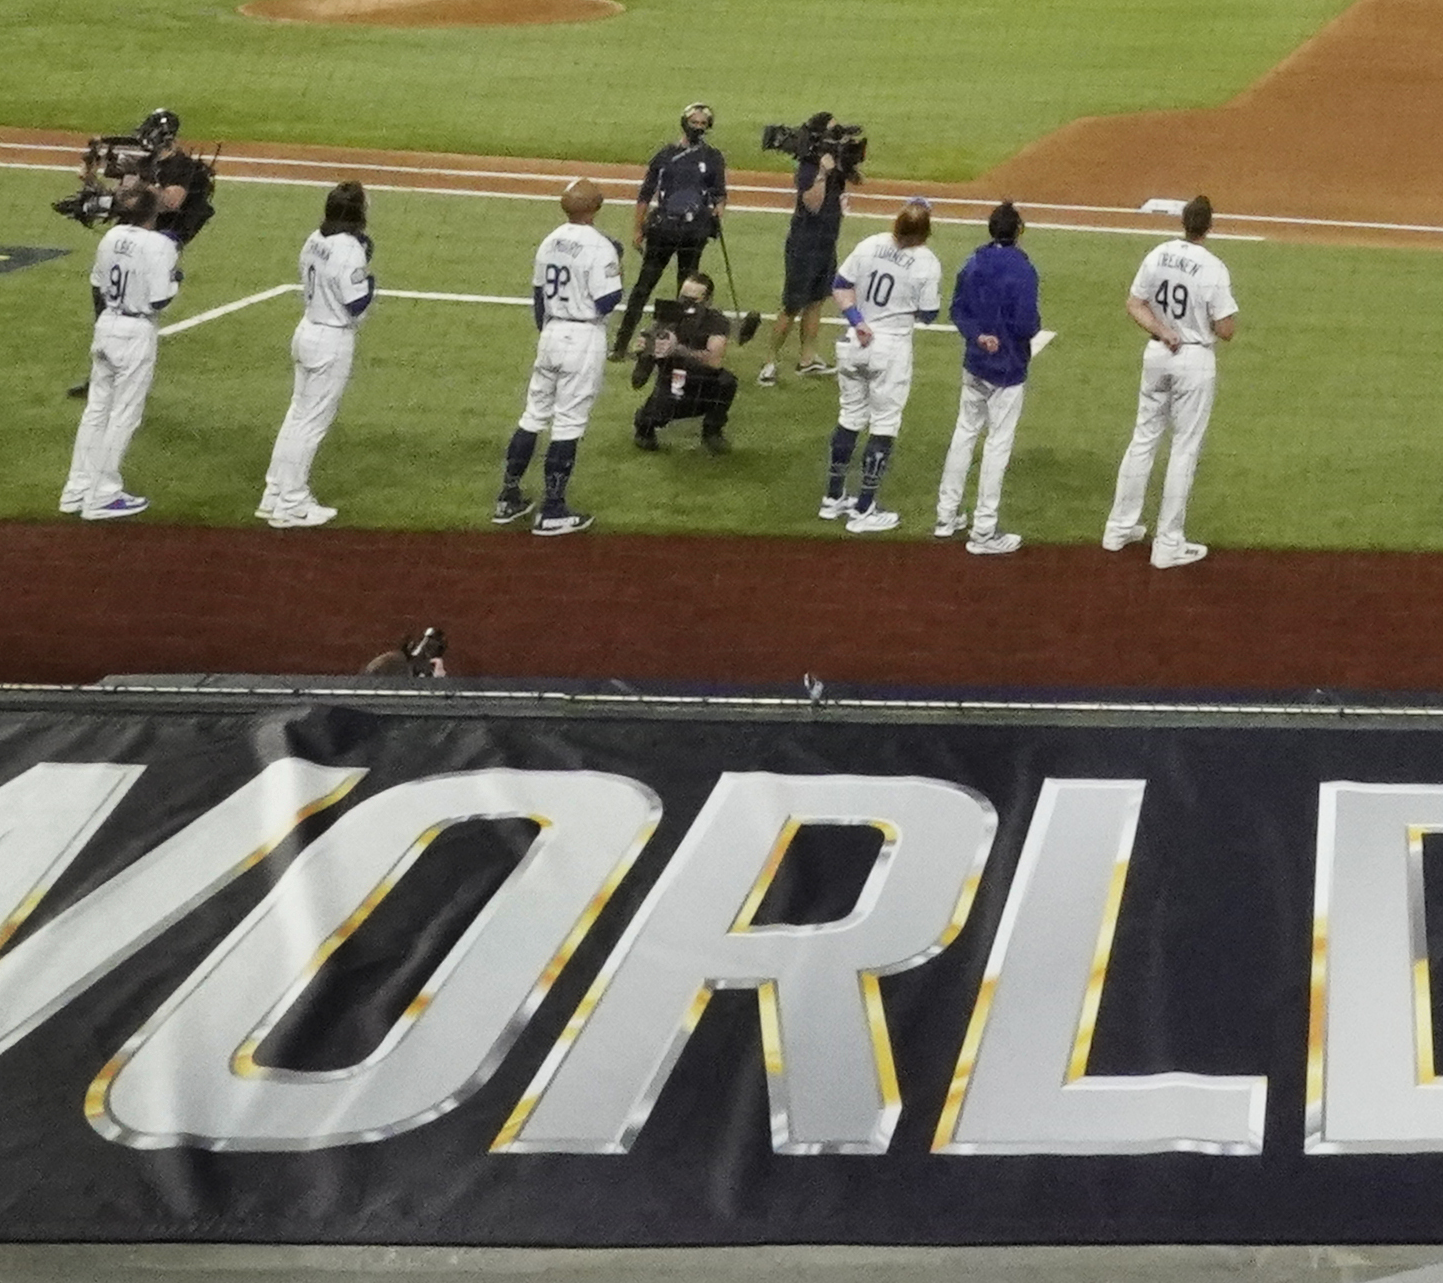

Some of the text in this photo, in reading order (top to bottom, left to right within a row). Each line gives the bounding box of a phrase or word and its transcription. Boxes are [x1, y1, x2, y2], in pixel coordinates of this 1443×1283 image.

[874, 244, 916, 270] TURNER
[109, 264, 130, 304] 91
[545, 263, 571, 302] 92
[864, 269, 895, 308] 10
[1154, 279, 1189, 320] 49
